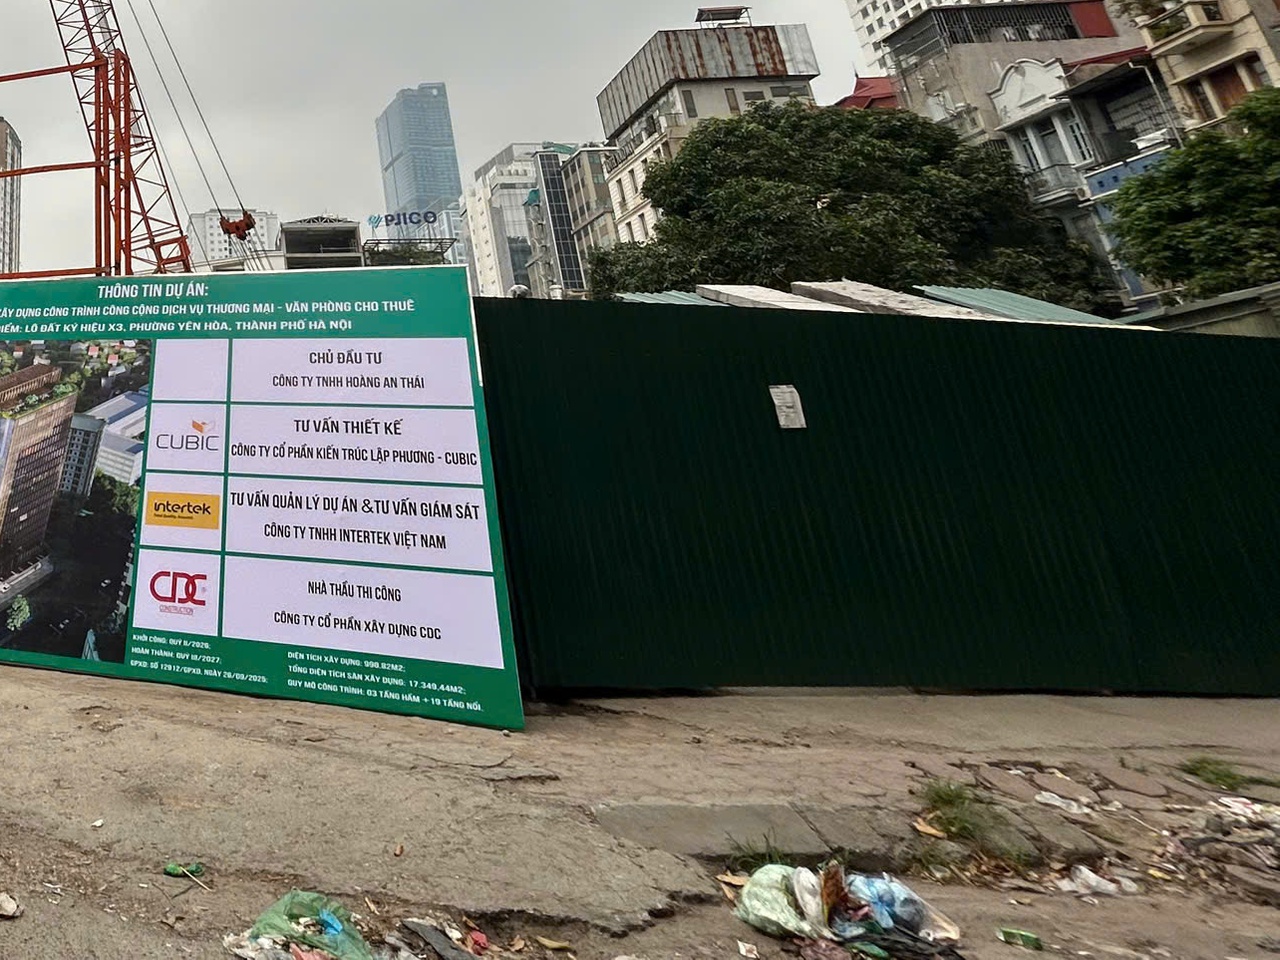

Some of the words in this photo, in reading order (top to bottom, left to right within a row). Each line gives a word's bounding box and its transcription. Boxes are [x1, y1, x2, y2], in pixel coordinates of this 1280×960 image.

[384, 211, 437, 226] PJICO
[98, 283, 138, 298] THÔNG
[142, 284, 162, 297] TIN
[165, 283, 184, 299] DỰ
[186, 280, 209, 296] ÁN:
[16, 307, 41, 319] DỰNG
[43, 306, 69, 317] CÔNG
[71, 305, 100, 316] TRÌNH
[102, 304, 130, 315] CÔNG
[132, 304, 159, 316] CỘNG
[162, 305, 186, 316] DỊCH
[189, 304, 204, 315] VỤ
[206, 303, 250, 314] THƯƠNG
[252, 303, 274, 314] MẠI
[285, 300, 308, 312] VĂN
[312, 300, 351, 312] PHÒNG
[354, 301, 379, 312] CHO
[381, 299, 415, 311] THUÊ
[25, 323, 38, 333] LÔ
[40, 322, 61, 332] ĐẤT
[80, 322, 105, 333] HIỆU
[130, 321, 175, 331] PHƯỜNG
[178, 321, 201, 330] YÊN
[235, 320, 277, 330] THÀNH
[280, 319, 307, 330] PHỐ
[309, 319, 326, 330] HÀ
[329, 319, 352, 331] NỘI
[309, 349, 333, 364] CHỦ
[337, 349, 362, 364] ĐẦU
[365, 352, 382, 364] TƯ
[272, 374, 298, 387] CÔNG
[301, 376, 313, 386] TY
[316, 376, 343, 387] TNHH
[346, 375, 380, 388] HOÀNG
[383, 377, 398, 388] AN
[400, 375, 424, 388] THÁI
[294, 419, 310, 432] TƯ
[313, 417, 339, 433] VẤN
[343, 418, 380, 434] THIẾT
[384, 418, 403, 435] KẾ
[156, 434, 219, 450] CUBIC
[231, 442, 256, 456] CÔNG
[258, 445, 270, 457] TY
[273, 441, 286, 458] CỔ
[288, 443, 313, 459] PHẦN
[316, 444, 339, 460] KIẾN
[342, 446, 368, 461] TRÚC
[370, 447, 390, 464] LẬP
[392, 450, 434, 464] PHƯƠNG
[445, 452, 477, 466] CUBIC
[154, 501, 211, 515] intertek
[231, 492, 244, 506] TƯ
[247, 490, 269, 507] VẤN
[272, 491, 302, 509] QUẢN
[306, 494, 320, 510] LÝ
[323, 497, 338, 514] DỰ
[341, 496, 357, 512] ÁN
[392, 497, 417, 516] VẤN
[420, 500, 452, 518] GIÁM
[455, 502, 479, 520] SÁT
[264, 522, 290, 538] CÔNG
[293, 525, 306, 539] TY
[309, 527, 336, 541] TNHH
[340, 529, 391, 545] INTERTEK
[393, 530, 417, 549] VIỆT
[421, 534, 446, 549] NAM
[150, 571, 207, 606] CDC
[308, 579, 327, 594] NHÀ
[329, 580, 354, 597] THẦU
[356, 585, 372, 599] THI
[375, 585, 401, 602] CÔNG
[274, 610, 300, 625] CÔNG
[302, 615, 315, 626] TY
[318, 612, 331, 628] CỔ
[334, 616, 361, 631] PHẦN
[364, 619, 385, 634] XÂY
[388, 623, 417, 638] DỰNG
[420, 626, 441, 640] CDC
[288, 651, 304, 660] DIỆN
[306, 653, 322, 662] TÍCH
[324, 655, 338, 663] XÂY
[204, 669, 222, 677] NGÀY
[288, 664, 307, 674] TỔNG
[309, 668, 326, 676] DIỆN
[328, 670, 346, 678] TÍCH
[364, 674, 380, 682] XÂY
[288, 679, 302, 687] QUY
[304, 681, 316, 689] MÔ
[317, 682, 338, 692] CÔNG
[366, 689, 377, 697] 03
